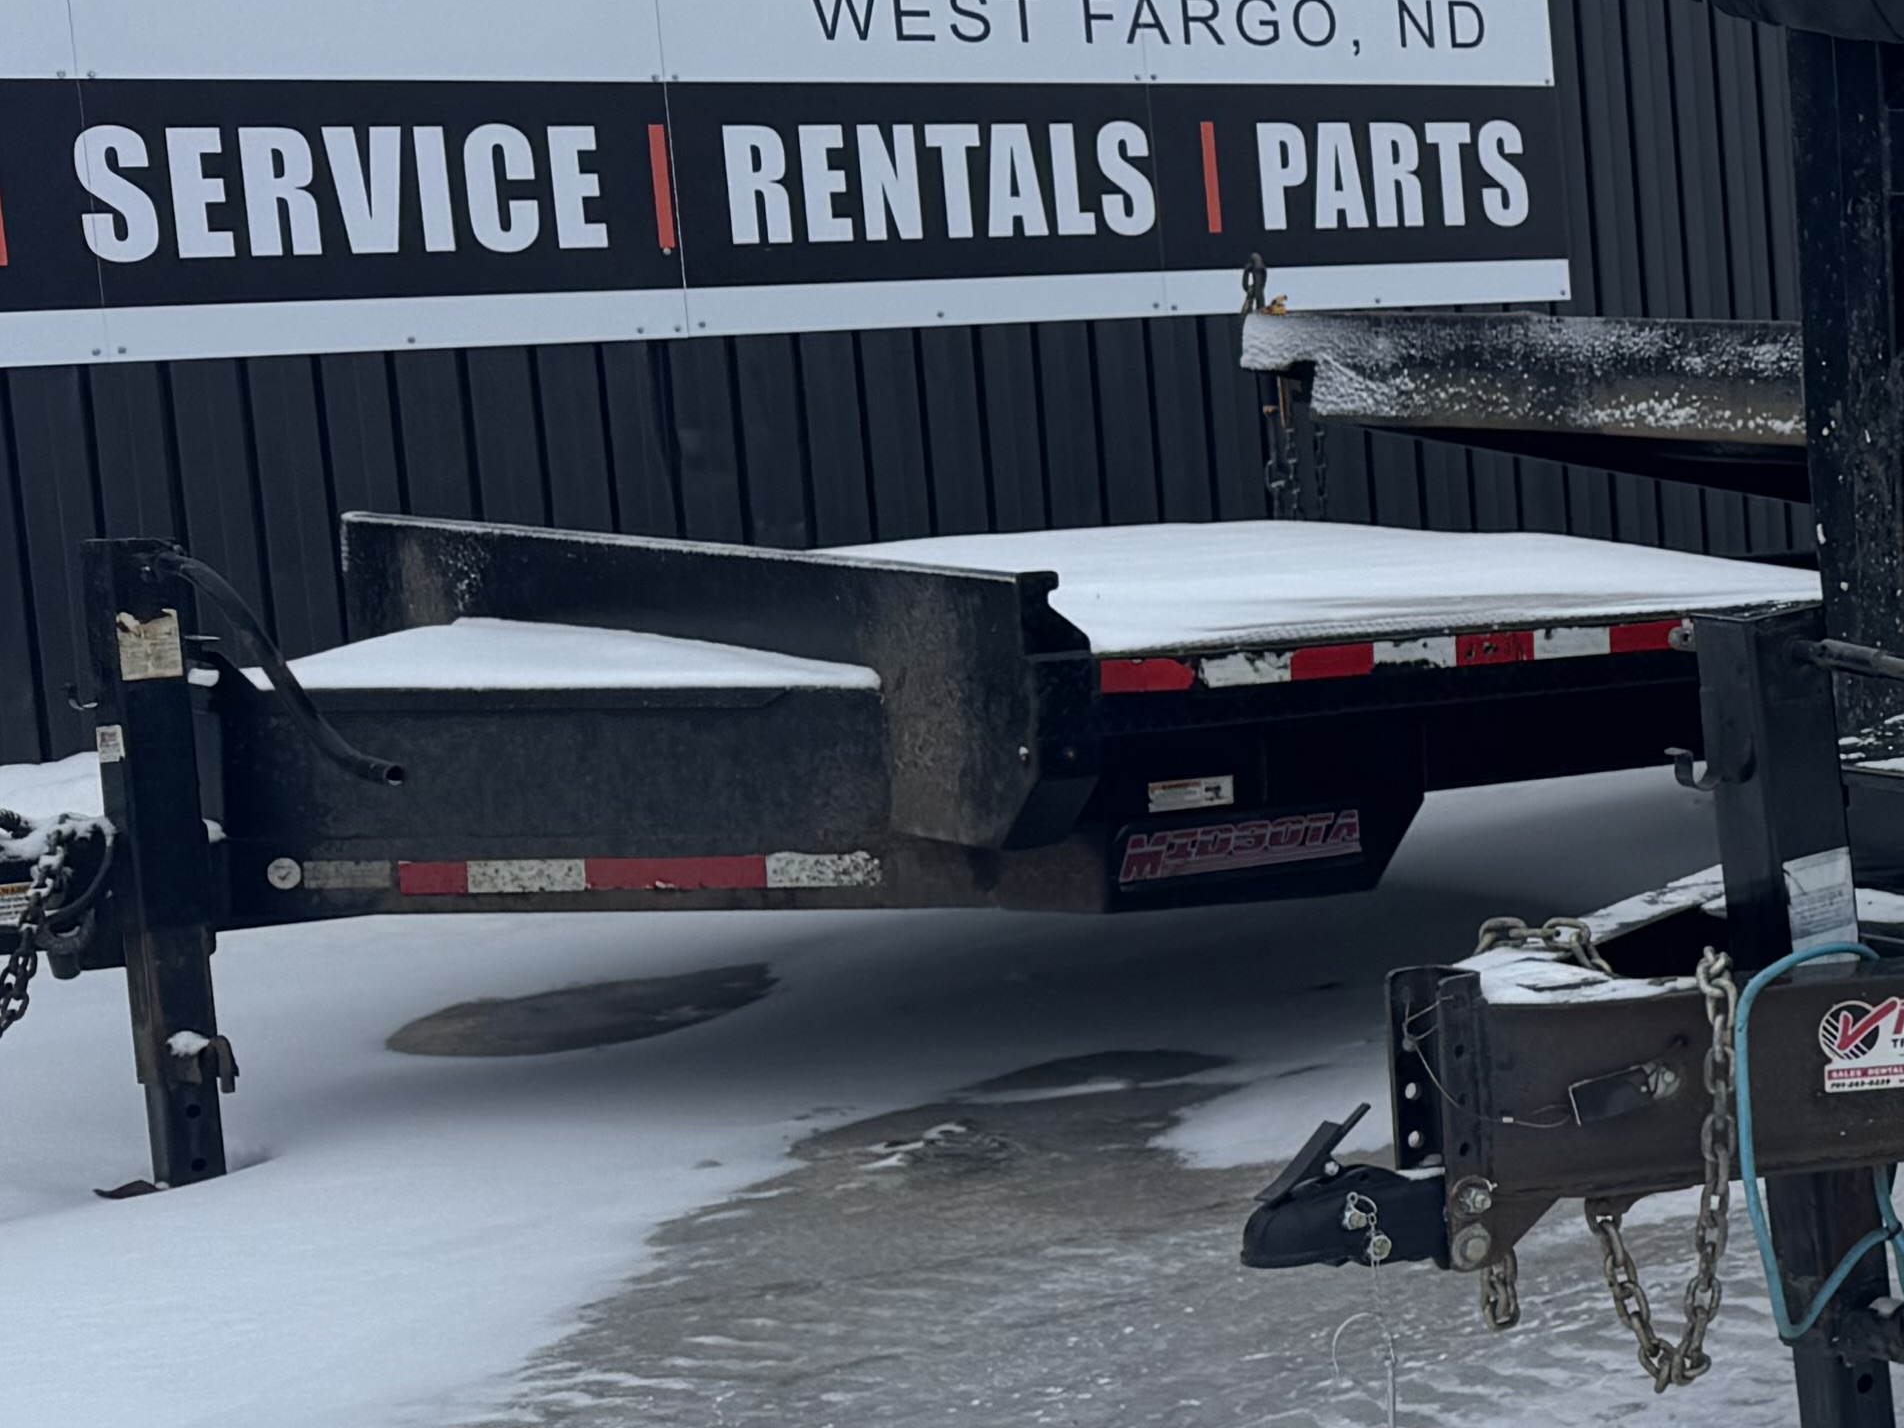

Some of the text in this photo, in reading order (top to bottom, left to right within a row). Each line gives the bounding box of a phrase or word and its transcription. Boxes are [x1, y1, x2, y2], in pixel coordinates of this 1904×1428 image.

[72, 119, 1530, 264] SERVICE RENTALS PARTS
[1118, 809, 1361, 884] MIDSOTA
